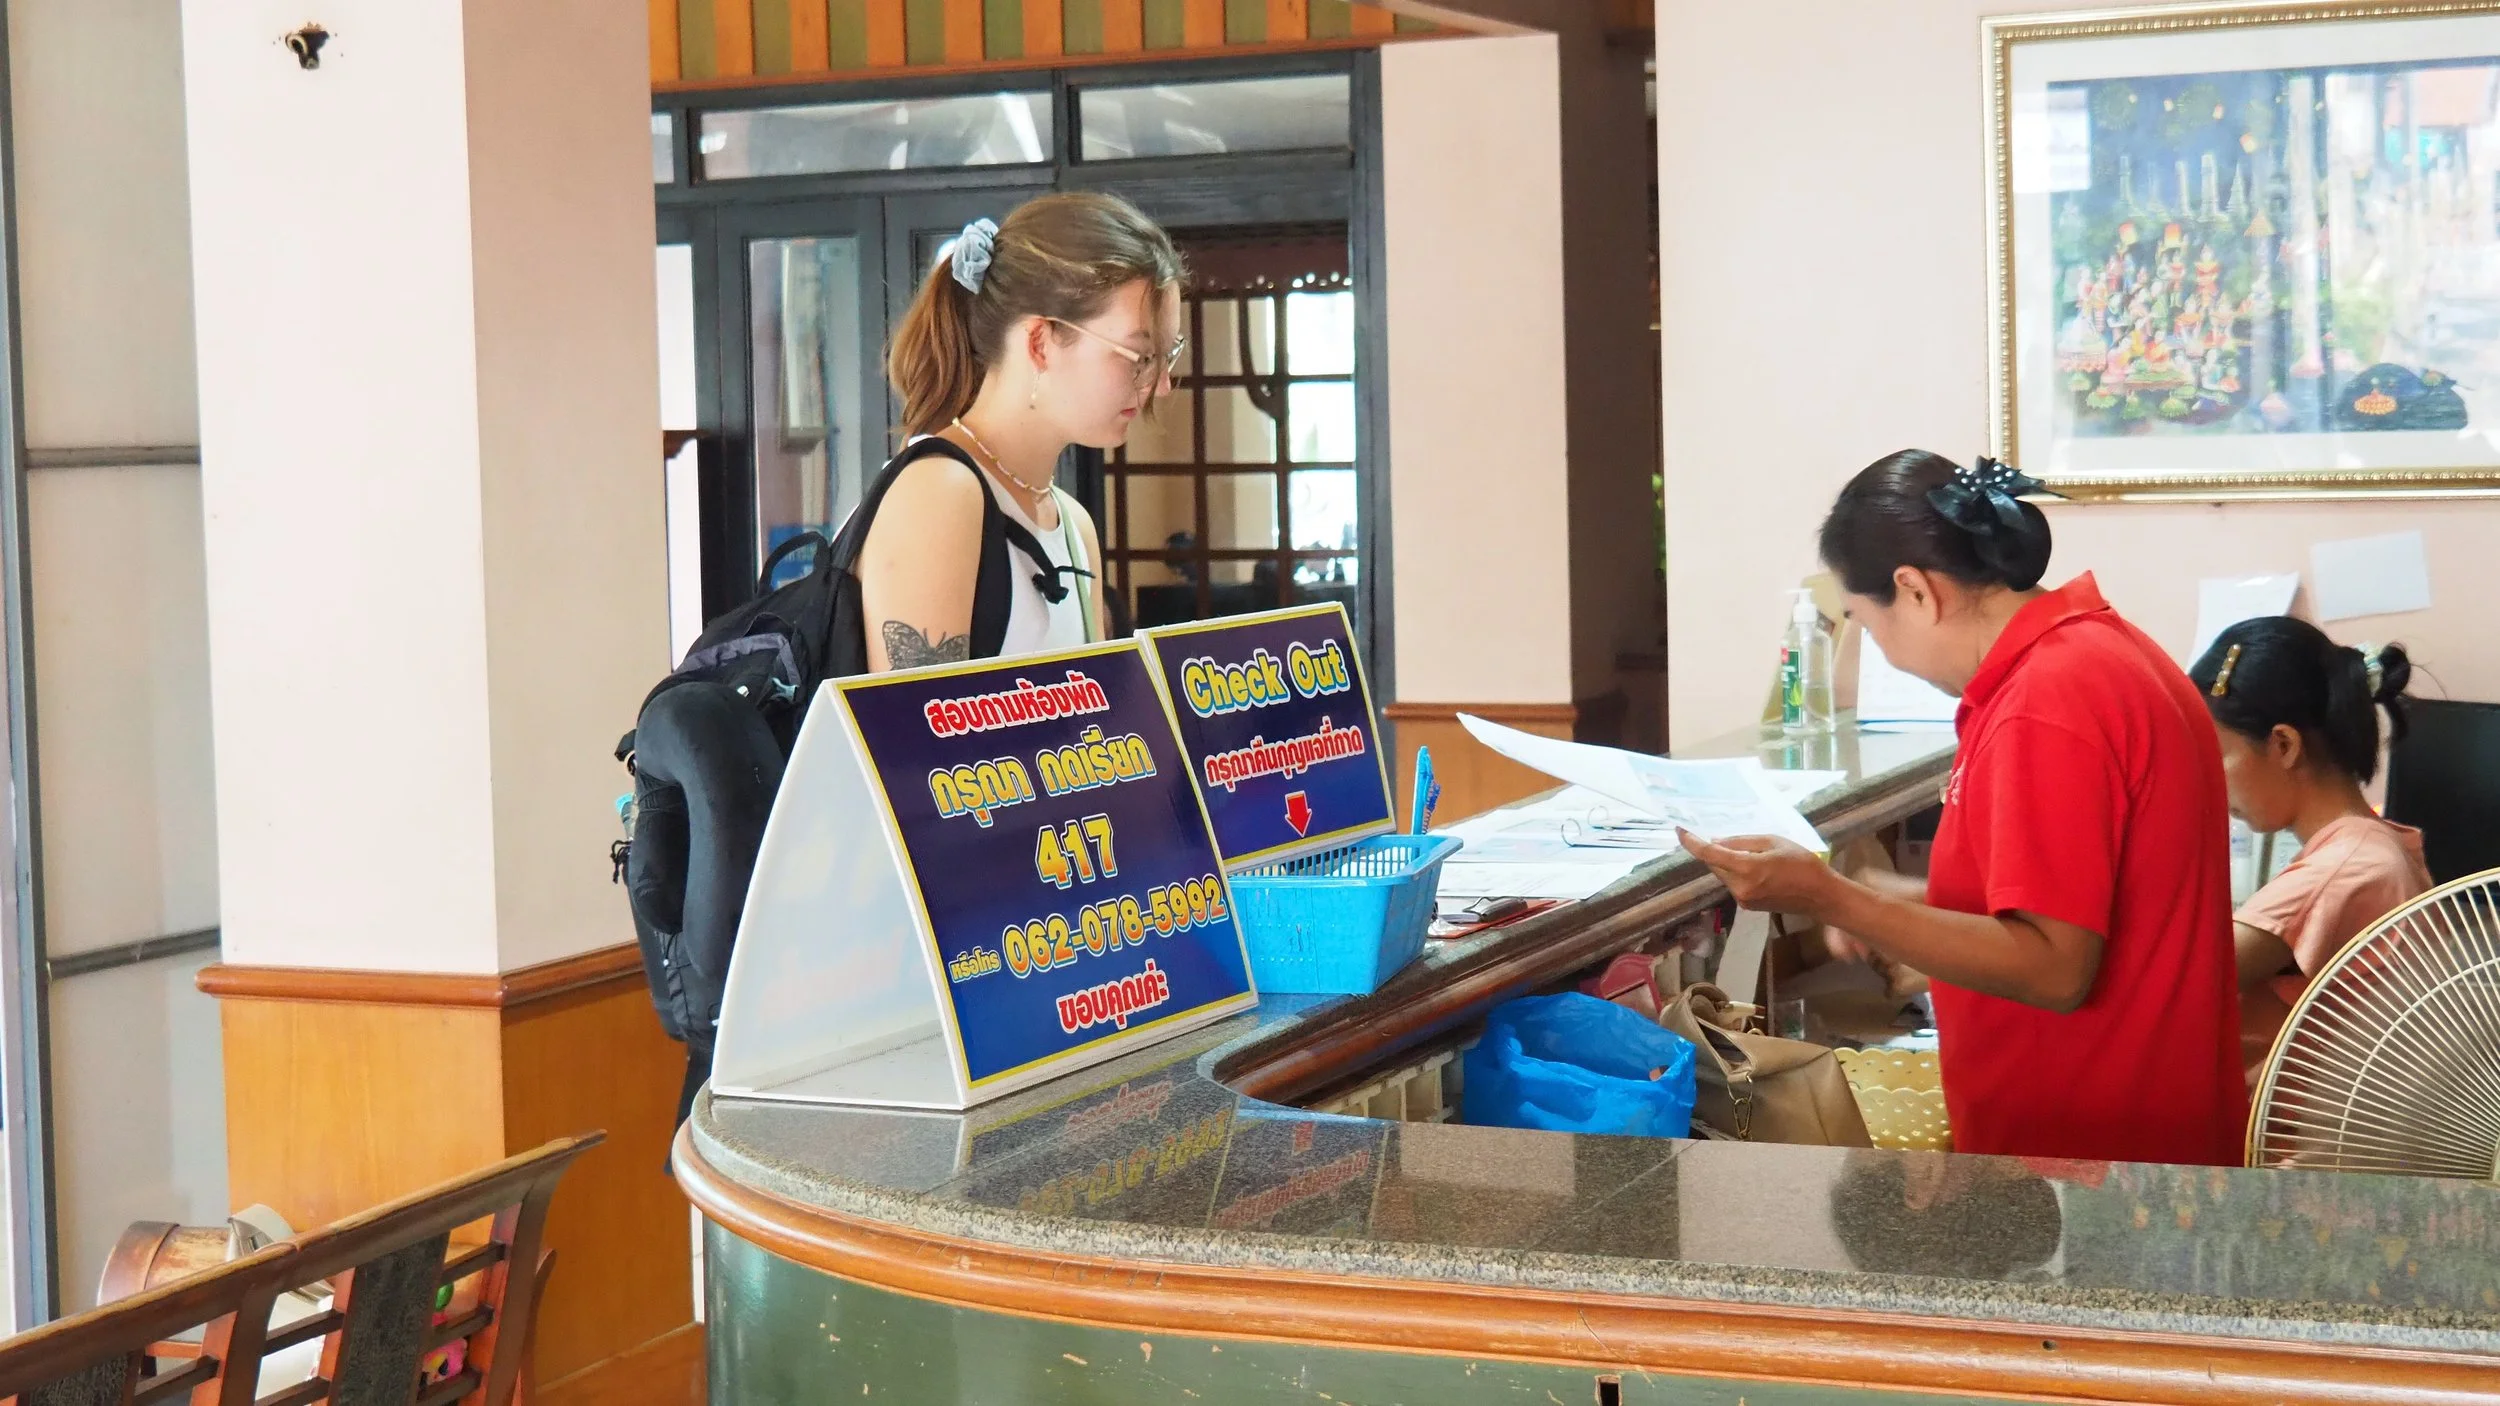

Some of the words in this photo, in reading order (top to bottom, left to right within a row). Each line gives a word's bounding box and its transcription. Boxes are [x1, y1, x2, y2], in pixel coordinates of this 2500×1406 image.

[924, 670, 1109, 737] สอบถามห้องพัก
[1181, 648, 1290, 718] Check
[1287, 639, 1350, 698] Out
[929, 756, 1036, 828] กรุณา
[1036, 725, 1157, 796] กดเรียก
[1205, 716, 1364, 792] กรุณาคืนกุญแจที่ถาด
[1035, 813, 1117, 889] 417
[949, 946, 1001, 983] หรือโทร
[1003, 873, 1229, 978] 062-078-5992
[1057, 958, 1169, 1033] ขอบคุณค่ะ
